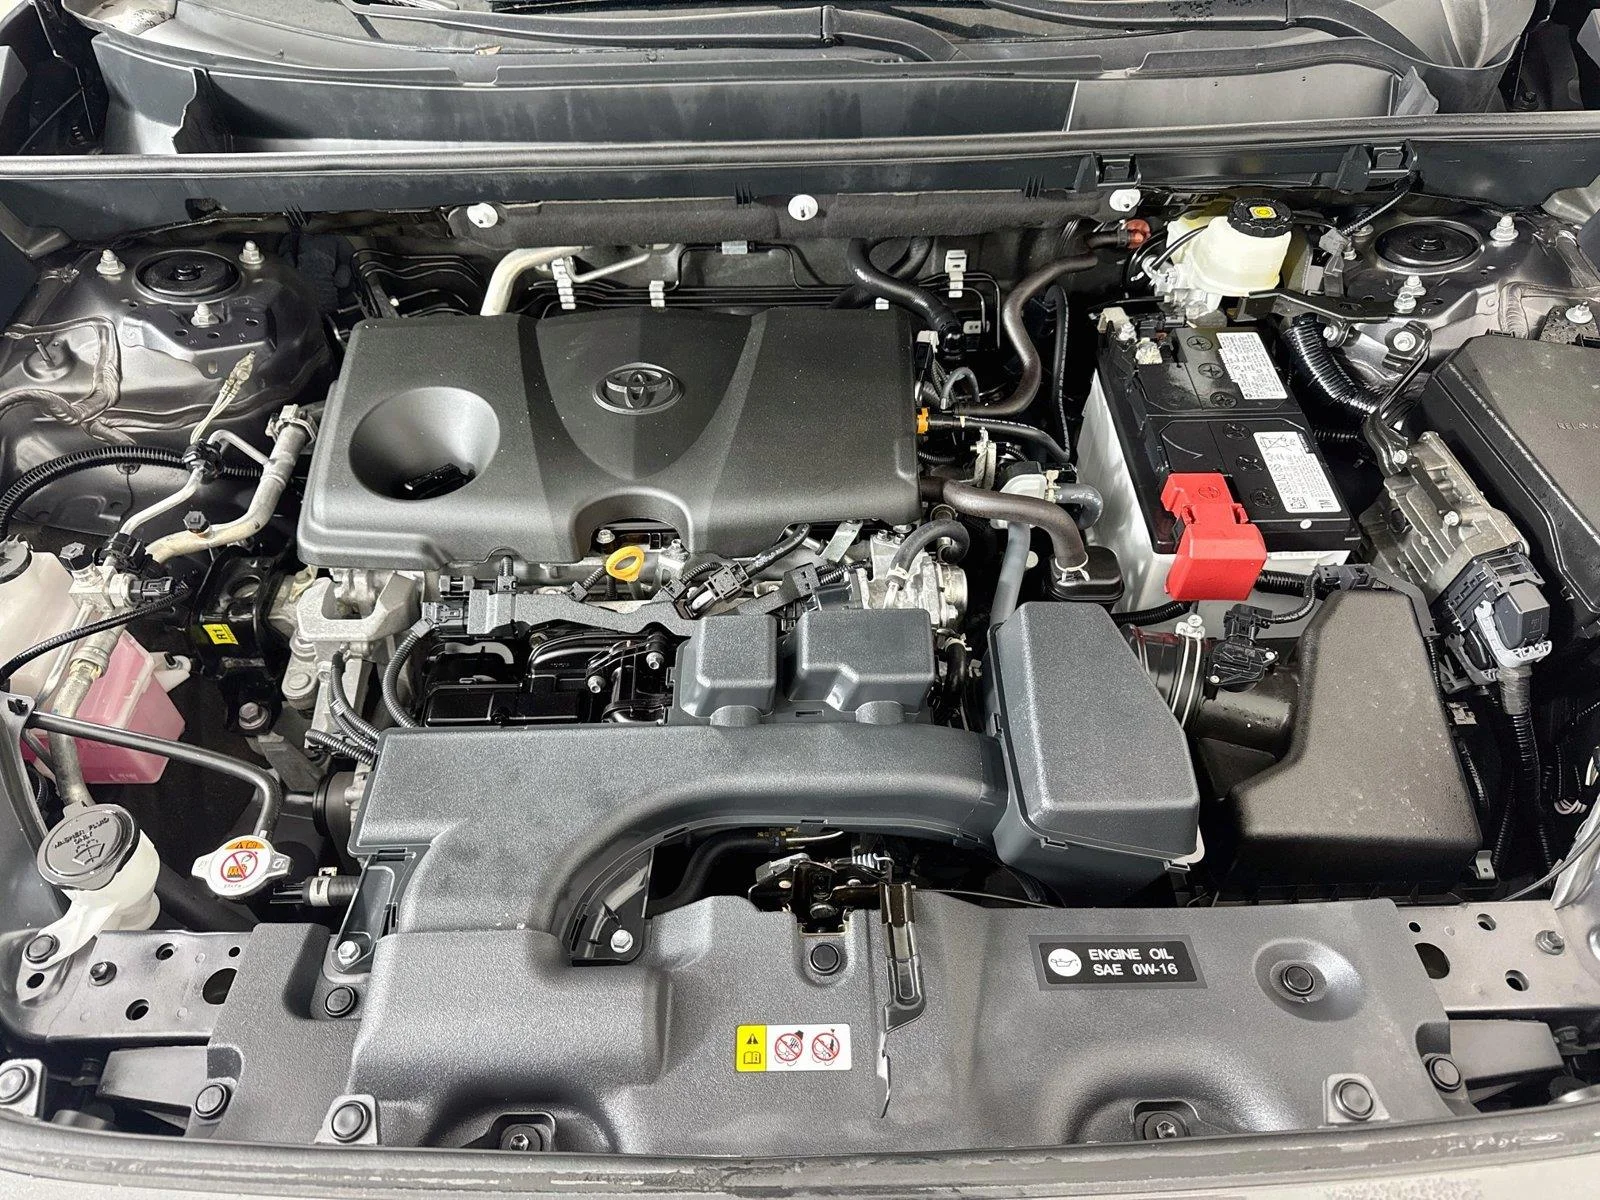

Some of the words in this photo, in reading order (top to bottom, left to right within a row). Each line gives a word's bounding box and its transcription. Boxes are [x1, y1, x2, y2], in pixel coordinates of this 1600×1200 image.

[1088, 949, 1141, 960] ENGINE
[1149, 948, 1174, 960] OIL
[1093, 963, 1124, 976] SAE
[1132, 963, 1179, 976] 0W-16
